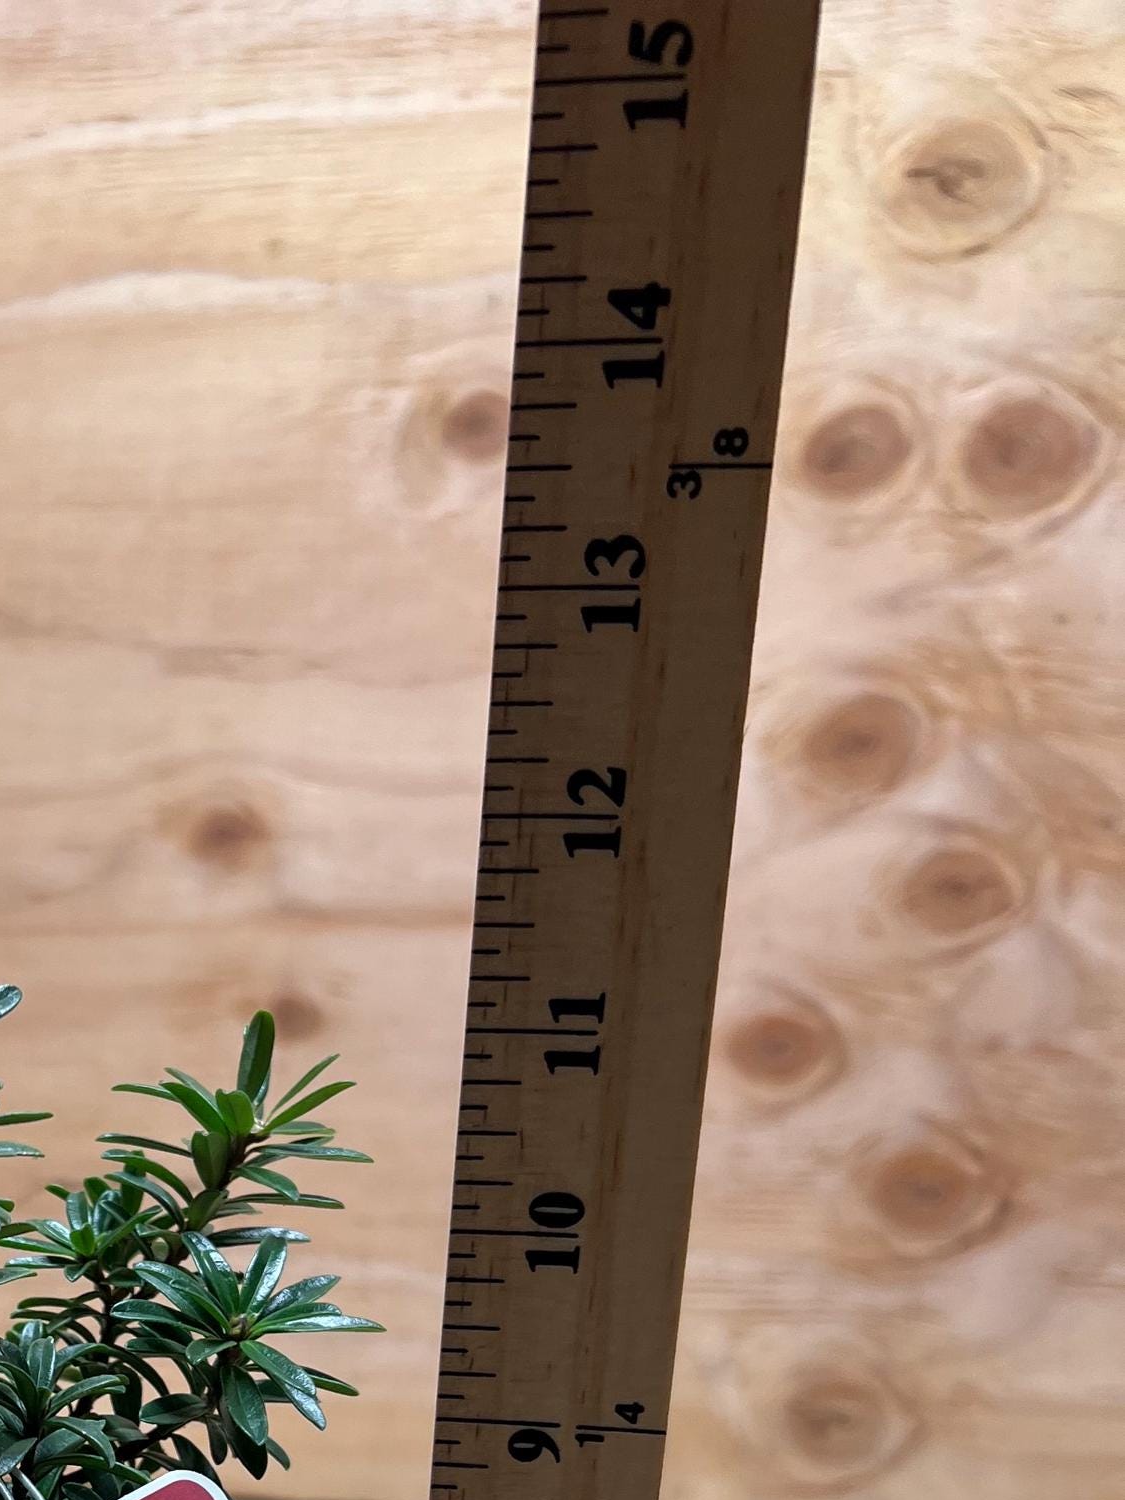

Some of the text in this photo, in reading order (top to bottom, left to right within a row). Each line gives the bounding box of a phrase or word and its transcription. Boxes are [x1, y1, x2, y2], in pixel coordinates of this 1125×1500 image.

[622, 19, 694, 130] 15
[601, 281, 672, 389] 14
[580, 534, 647, 633] 13
[561, 766, 627, 859] 12
[543, 992, 607, 1075] 11
[524, 1191, 586, 1274] 10
[506, 1428, 561, 1464] 9
